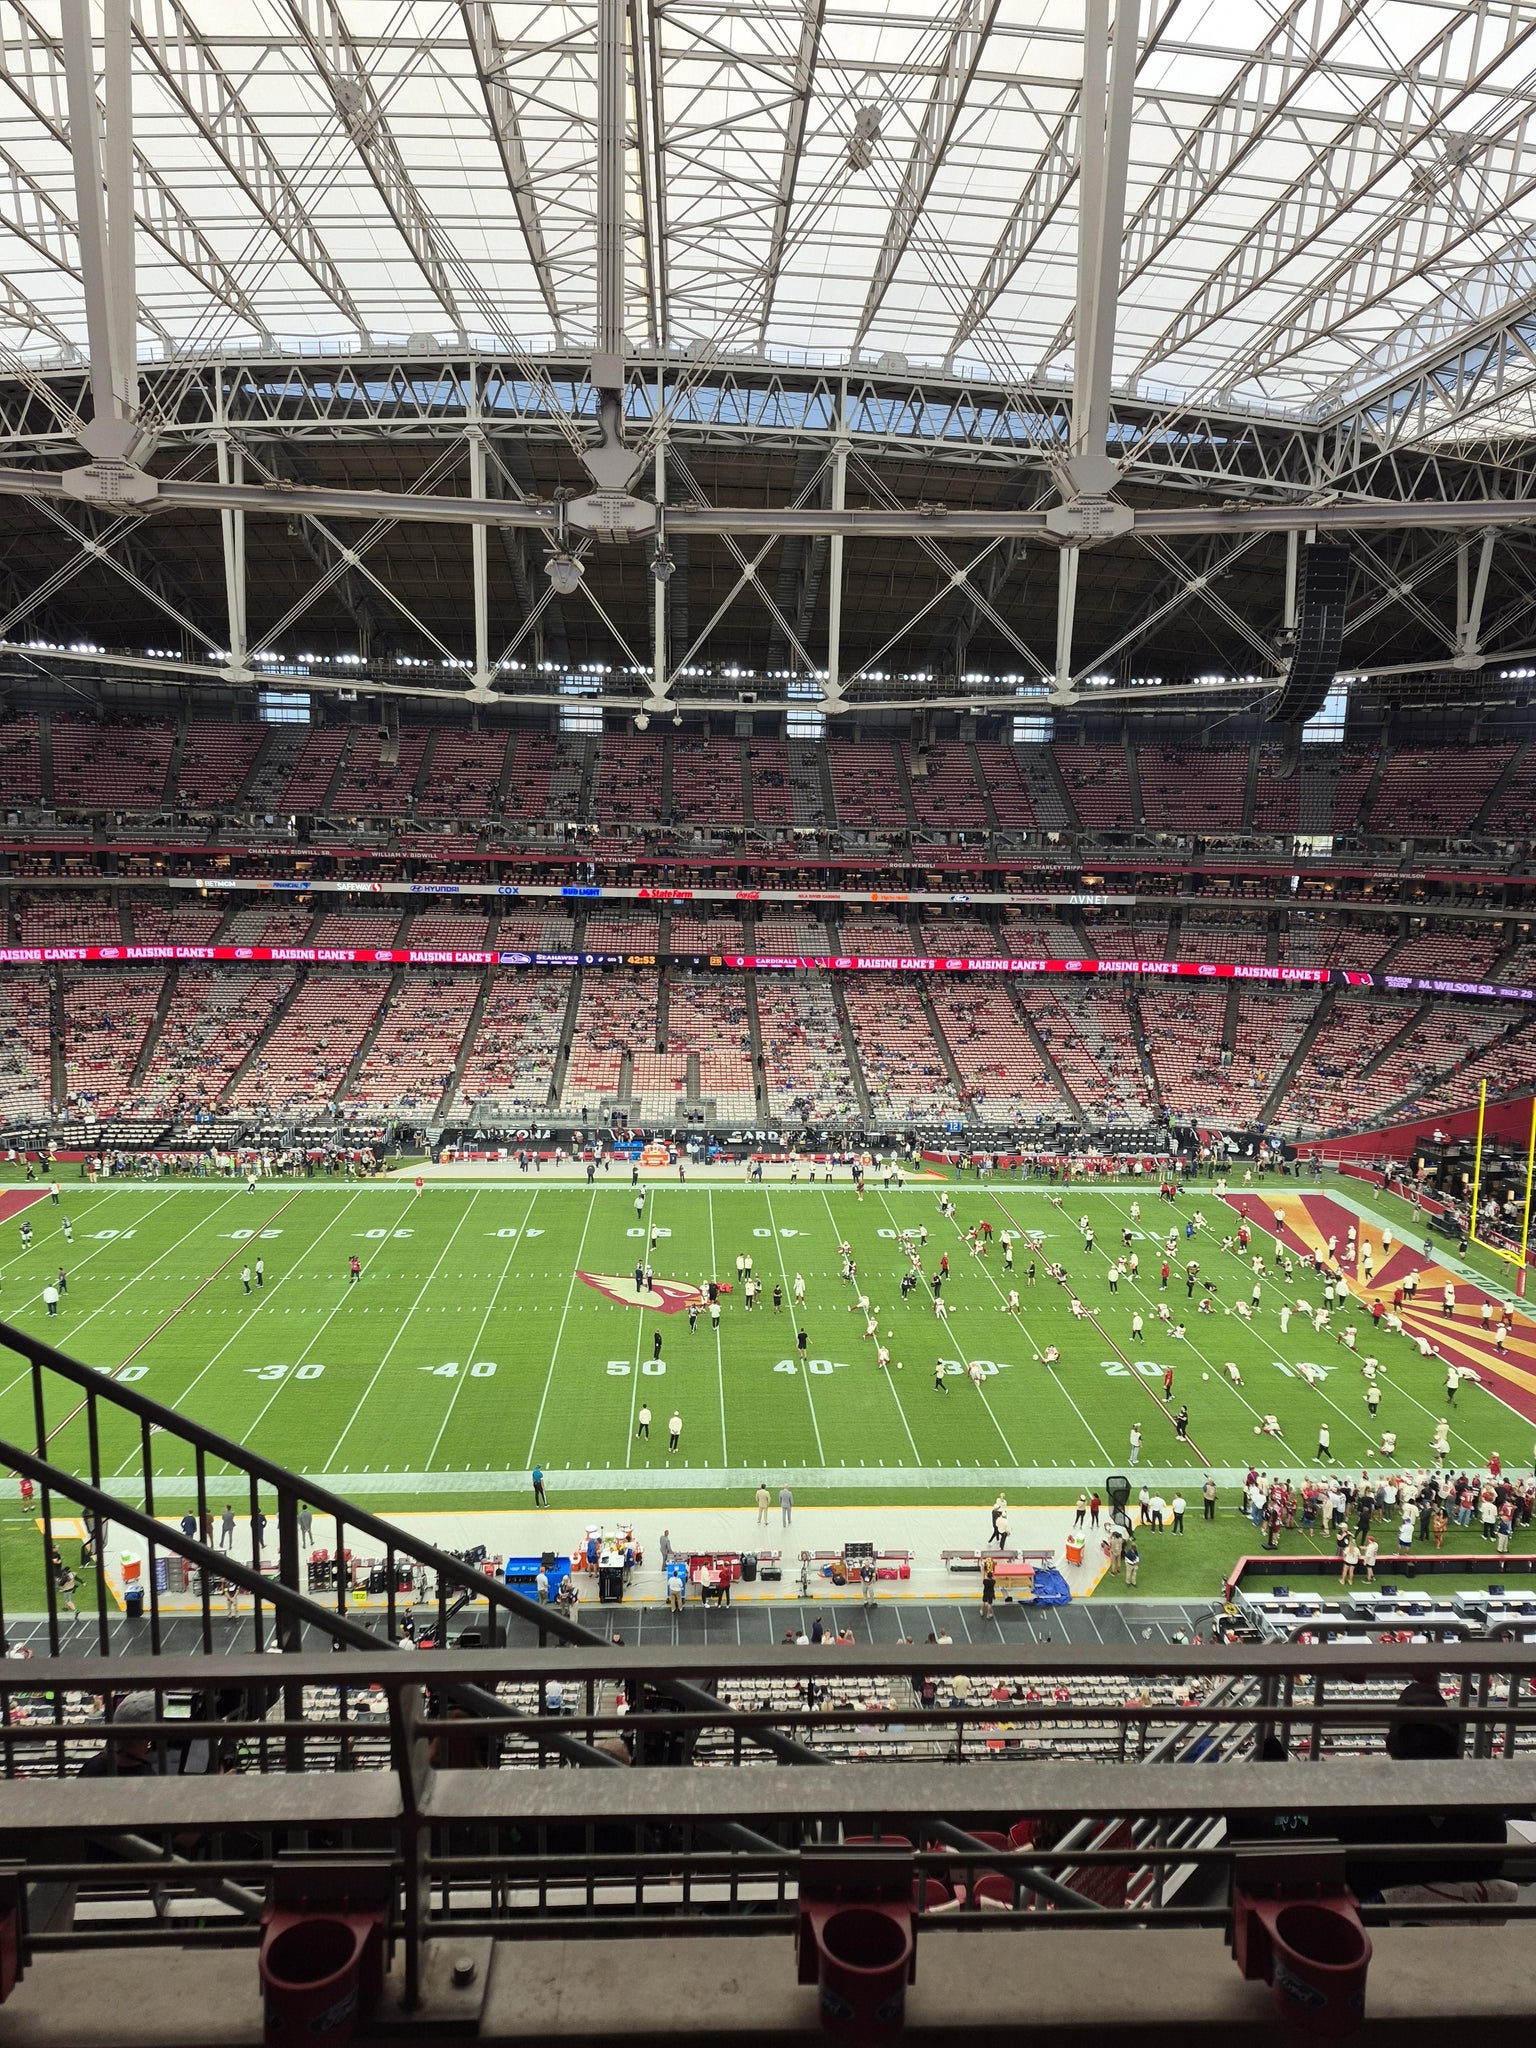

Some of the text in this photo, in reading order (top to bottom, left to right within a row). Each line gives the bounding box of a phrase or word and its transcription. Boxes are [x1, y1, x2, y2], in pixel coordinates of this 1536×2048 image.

[336, 883, 371, 891] SAFEWAY
[498, 886, 519, 894] COX
[1069, 896, 1109, 904] AVNET
[0, 949, 41, 960] AISING
[44, 948, 87, 959] CANE'S
[127, 947, 173, 958] RAISING
[176, 947, 214, 958] CANE'S
[271, 949, 355, 960] RAISING CANE'S
[410, 951, 492, 962] RAISING CANE'S
[585, 955, 594, 964] 0
[617, 955, 623, 964] 1
[627, 956, 656, 964] 42:53
[736, 957, 744, 965] 0
[857, 959, 898, 968] RAISING
[900, 959, 935, 969] CANE'S
[968, 960, 1009, 969] RAISING
[1011, 960, 1046, 970] CANE'S
[1098, 961, 1178, 973] RAISING CANE'S
[1234, 966, 1321, 980] RAISING CANE'S
[1385, 976, 1412, 984] SEASON
[1418, 980, 1496, 995] M. WILSON SR.
[1520, 989, 1533, 999] 28
[949, 1122, 958, 1130] 12
[230, 1229, 284, 1239] 20
[364, 1228, 415, 1238] 30
[496, 1228, 545, 1237] 40
[753, 1228, 798, 1238] 40
[1454, 1269, 1509, 1294] STOP
[257, 1364, 326, 1380] 30
[432, 1362, 497, 1377] 40
[606, 1359, 666, 1376] 50
[772, 1359, 834, 1375] 40
[1100, 1361, 1165, 1376] 20
